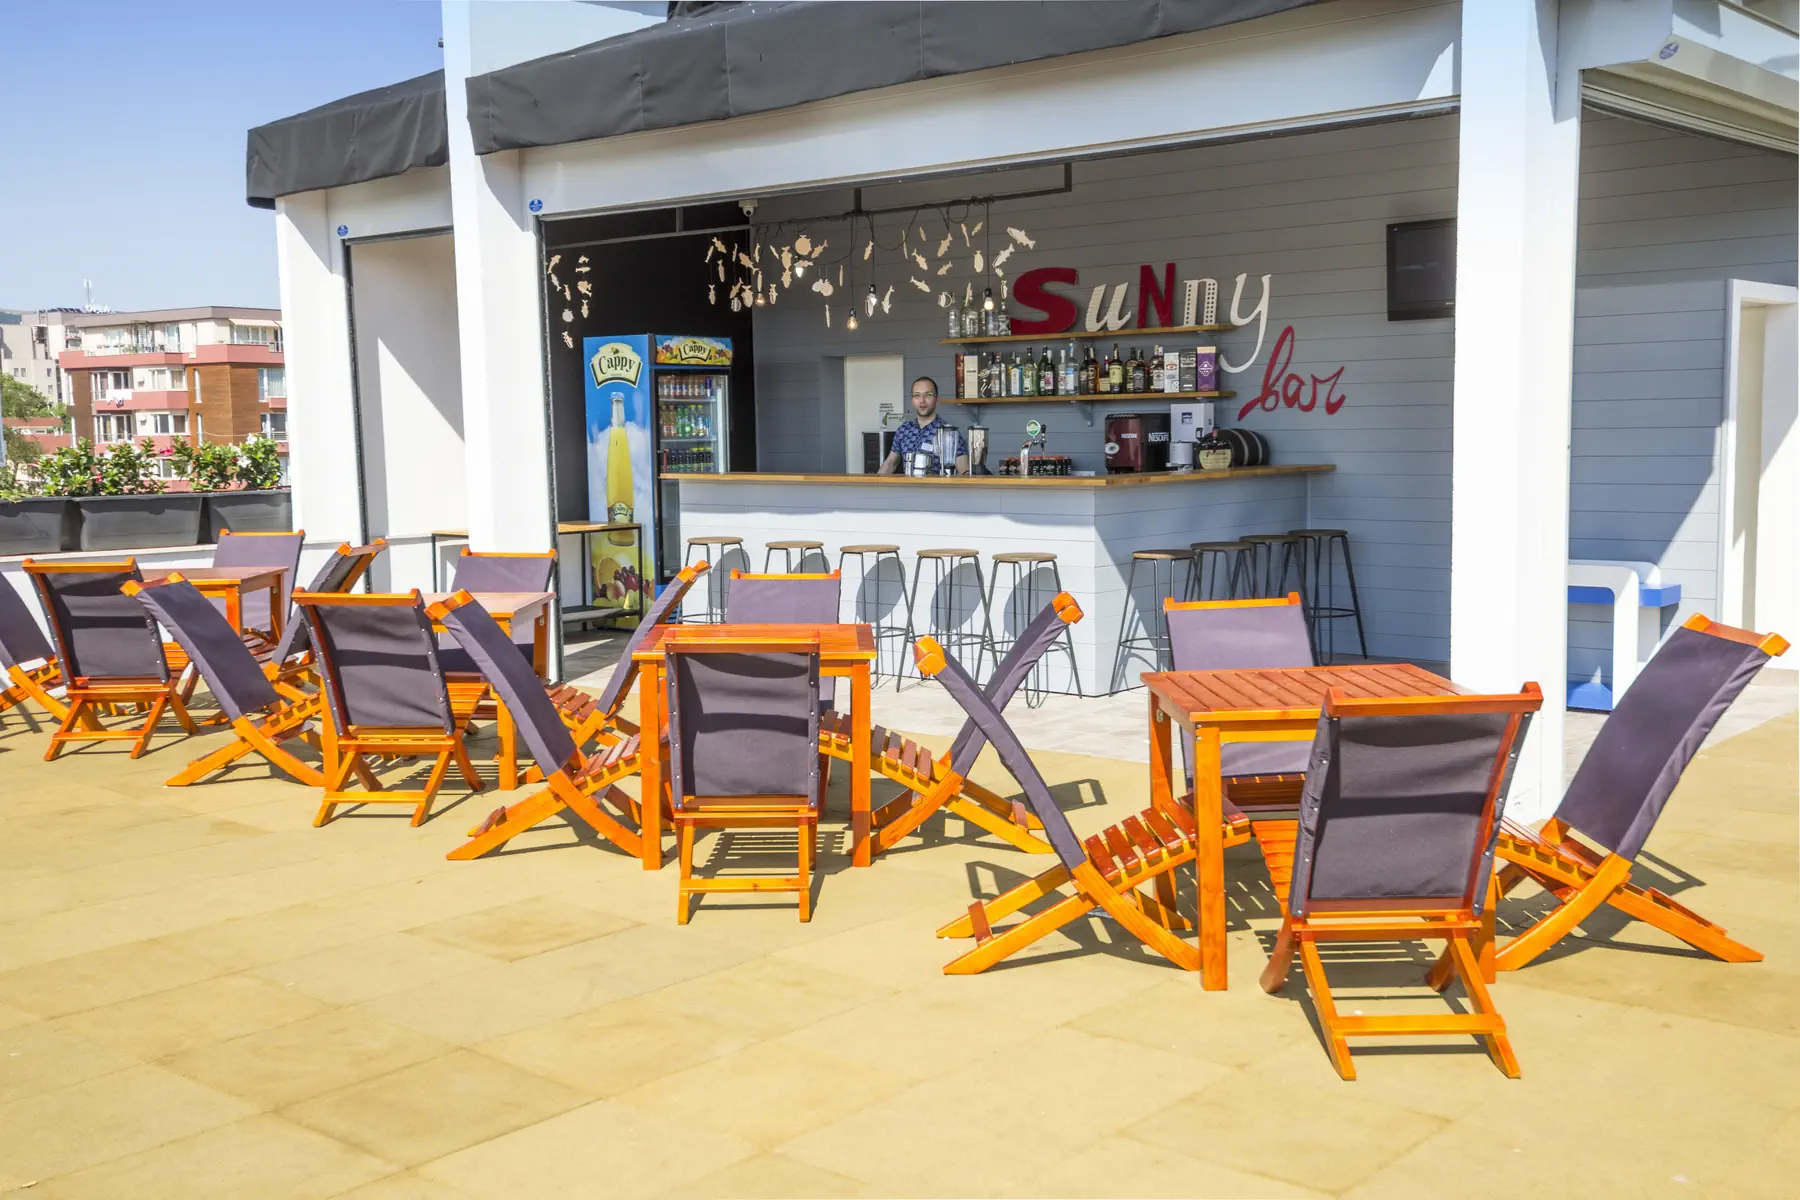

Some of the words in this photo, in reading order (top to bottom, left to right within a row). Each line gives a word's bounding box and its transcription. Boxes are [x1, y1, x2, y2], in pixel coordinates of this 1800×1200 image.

[683, 343, 708, 356] Cappy
[598, 355, 636, 375] Cappy
[1237, 325, 1346, 421] bar
